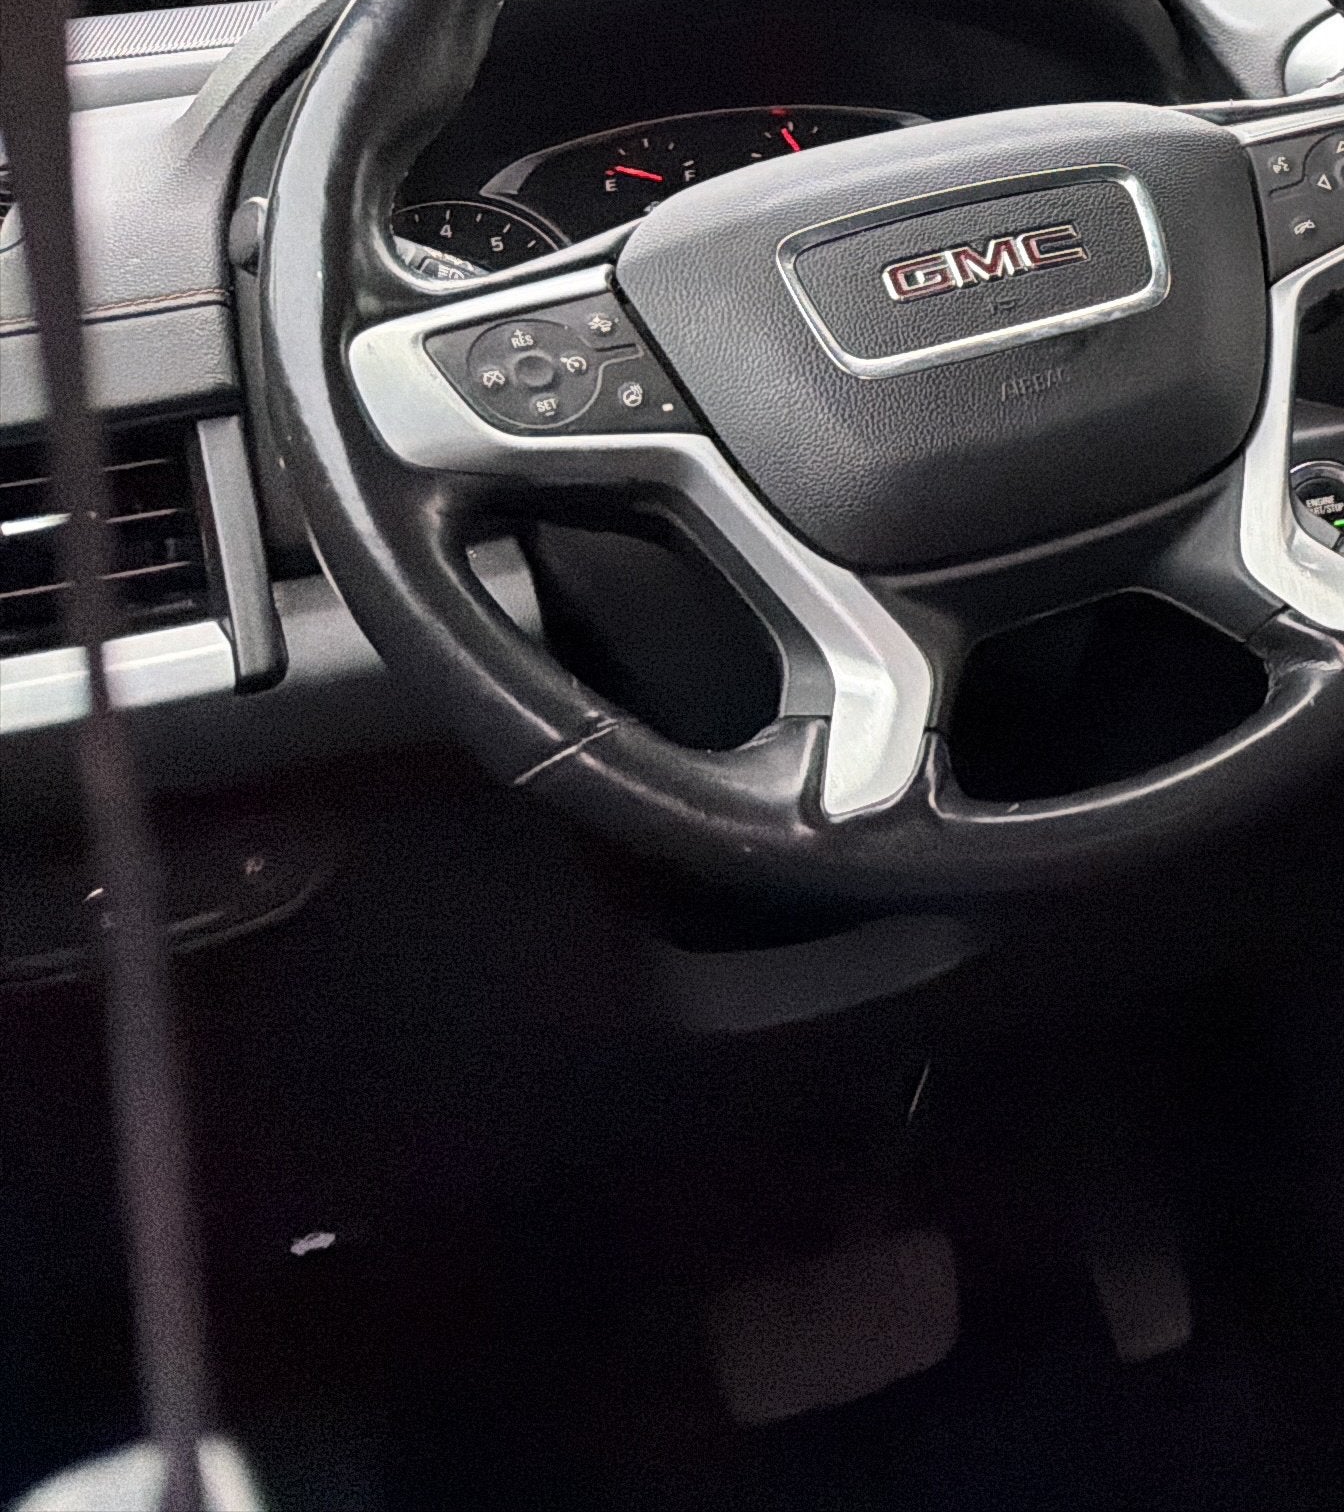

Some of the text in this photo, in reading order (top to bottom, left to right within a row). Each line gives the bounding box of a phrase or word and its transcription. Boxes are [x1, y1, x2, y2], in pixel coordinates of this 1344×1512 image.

[684, 169, 696, 182] F
[604, 178, 617, 193] E
[439, 224, 453, 239] 4
[490, 235, 504, 252] 5
[881, 223, 1090, 302] GMC
[510, 334, 535, 349] RES
[536, 397, 558, 414] SET
[1305, 494, 1336, 509] ENGINE
